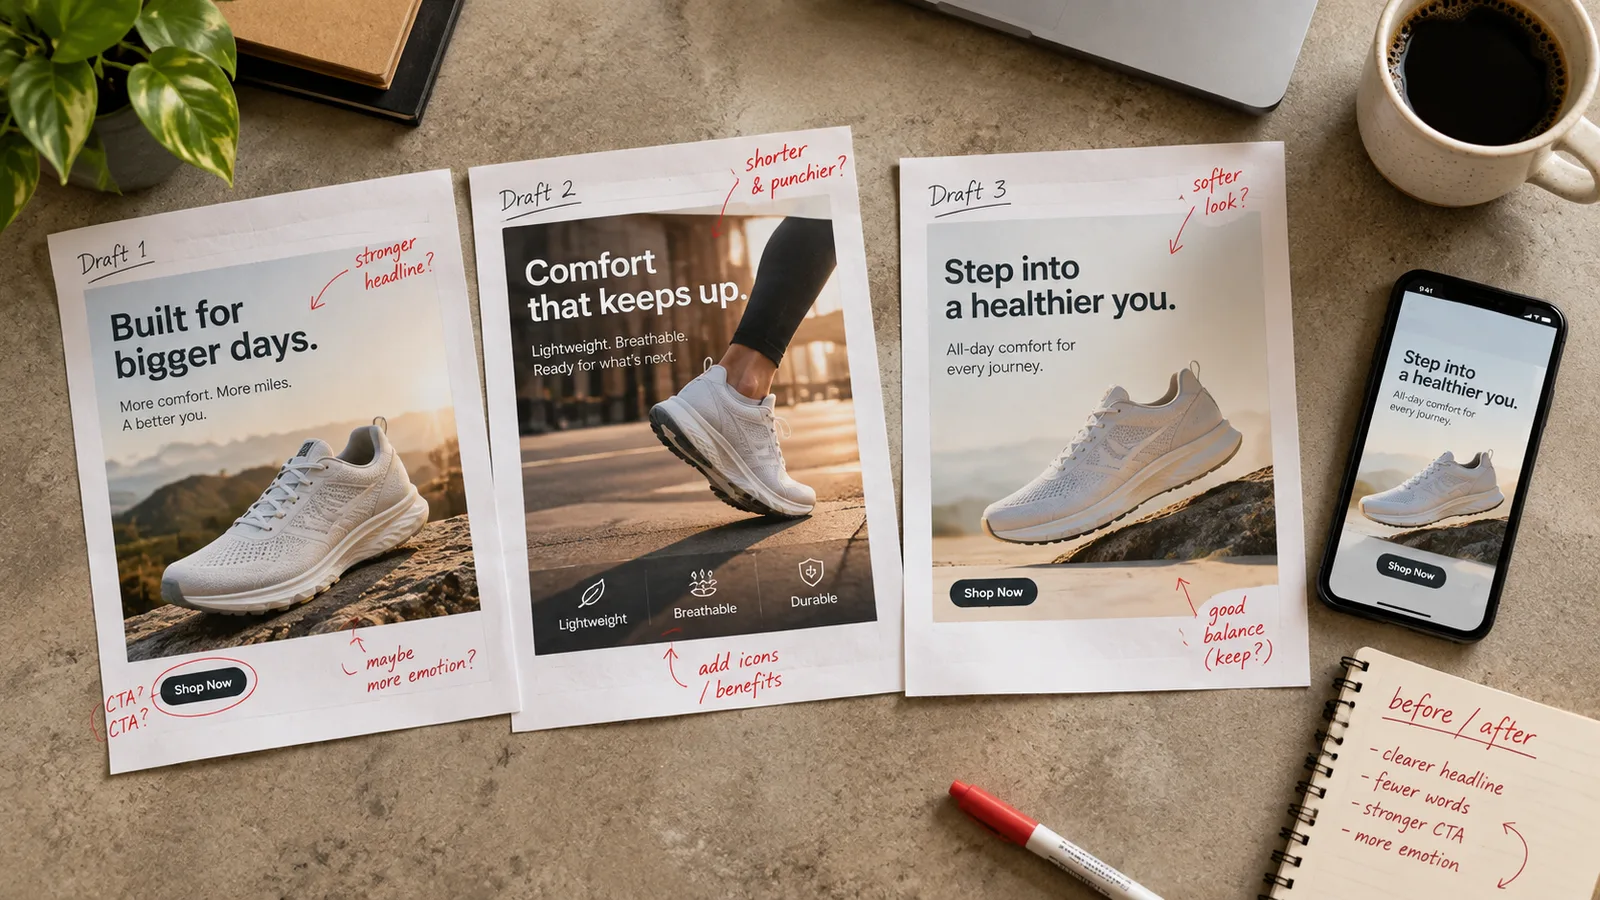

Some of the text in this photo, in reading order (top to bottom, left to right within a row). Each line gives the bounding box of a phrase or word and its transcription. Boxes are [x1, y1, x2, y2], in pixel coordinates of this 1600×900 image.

[746, 143, 808, 172] shorter
[751, 155, 847, 199] & punchier?
[1193, 167, 1243, 194] softer
[500, 180, 576, 212] Draft 2
[928, 179, 1007, 207] Draft 3
[1205, 187, 1250, 215] look?
[77, 240, 146, 275] Draft 1
[355, 237, 416, 272] stronger
[525, 250, 656, 287] Comfort
[365, 252, 434, 290] headline?
[944, 255, 1080, 288] Step into
[528, 281, 747, 322] that keeps up.
[945, 288, 1176, 319] a healthier you.
[110, 300, 244, 341] Built for
[115, 329, 318, 380] bigger days.
[532, 330, 688, 359] Lightweight. Breathable.
[946, 339, 1076, 358] All-day comfort for
[534, 360, 573, 377] Ready
[577, 358, 596, 372] for
[644, 351, 677, 365] next.
[947, 360, 1043, 377] every journey.
[1403, 350, 1476, 379] Step into
[120, 377, 292, 414] More comfort. More miles.
[1393, 390, 1476, 418] All-day comfort for
[1399, 370, 1518, 410] a healthier you.
[122, 410, 206, 431] A better you.
[1389, 402, 1451, 426] every journey.
[1388, 561, 1435, 581] Shop Now
[791, 593, 838, 608] Durable
[964, 587, 1023, 600] Shop Now
[559, 613, 627, 632] Lightweight
[674, 602, 737, 619] Breathable
[1208, 595, 1246, 626] good
[1203, 623, 1265, 645] balance
[366, 646, 414, 672] maybe
[699, 650, 779, 676] add icons
[1204, 639, 1273, 672] (keep?)
[367, 649, 477, 693] more emotion?
[716, 672, 782, 699] benefits
[105, 685, 144, 714] CTA?
[174, 677, 232, 697] Shop Now
[109, 707, 149, 738] CTA?
[1388, 686, 1453, 725] before
[1480, 716, 1537, 750] after
[1382, 746, 1436, 773] clearer
[1440, 761, 1504, 796] headline
[1373, 772, 1420, 800] fewer
[1426, 792, 1470, 814] words
[1363, 802, 1428, 834] stronger
[1432, 822, 1465, 844] CTA
[1354, 832, 1392, 851] more
[1398, 844, 1460, 872] emotion
